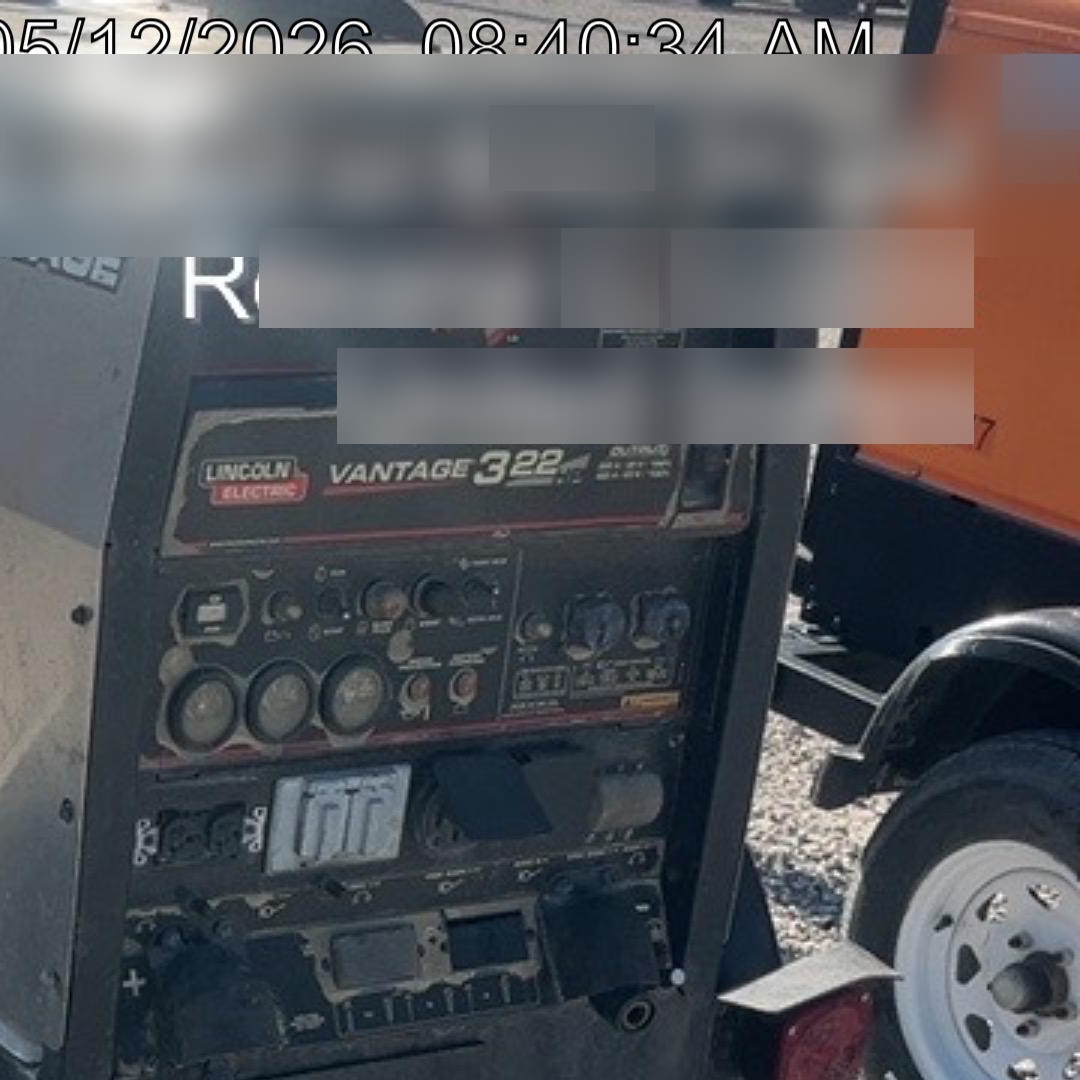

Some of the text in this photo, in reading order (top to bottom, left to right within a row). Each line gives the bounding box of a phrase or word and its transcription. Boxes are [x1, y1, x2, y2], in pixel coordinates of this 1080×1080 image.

[206, 461, 291, 482] LINCOLN
[329, 457, 473, 484] VANTAGE
[473, 448, 565, 486] 322
[222, 482, 298, 498] ELECTRIC
